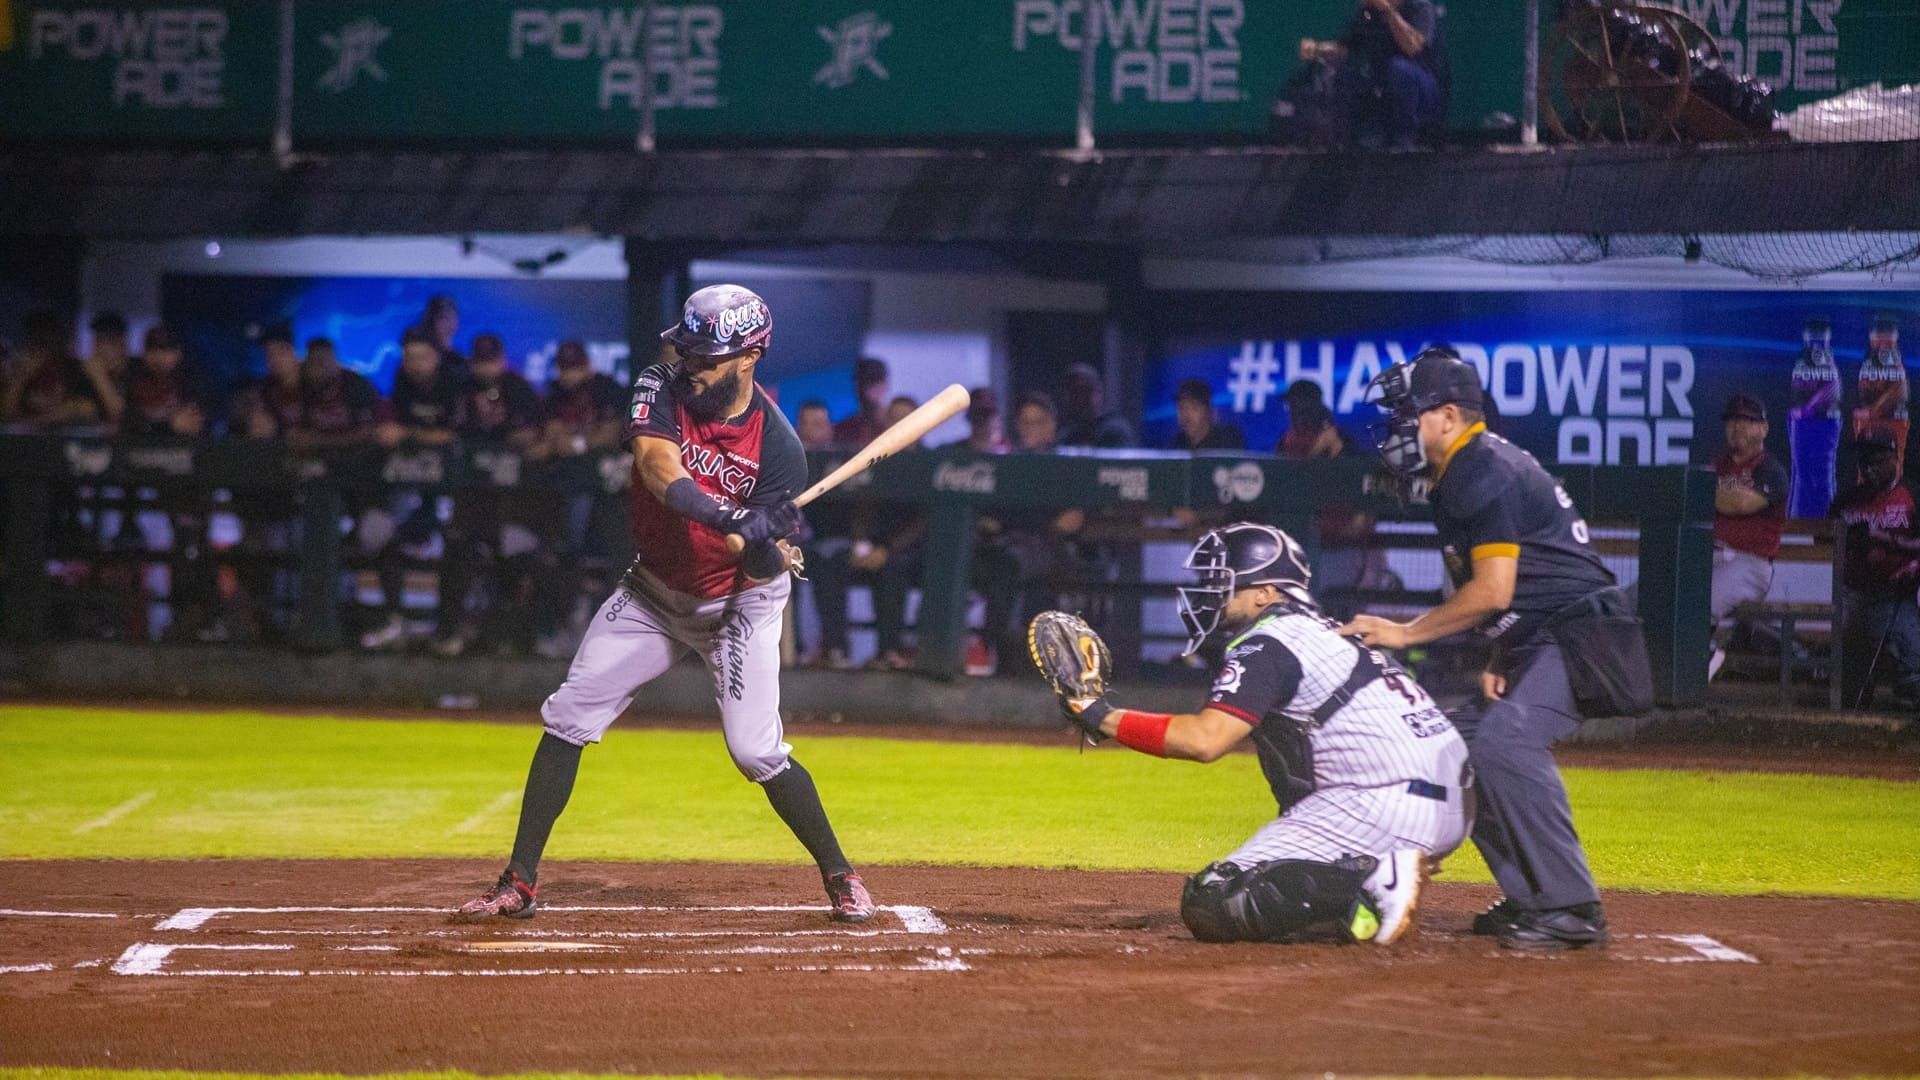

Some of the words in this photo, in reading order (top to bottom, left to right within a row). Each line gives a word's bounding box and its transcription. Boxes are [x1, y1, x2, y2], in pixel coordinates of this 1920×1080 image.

[31, 10, 229, 59] POWER
[510, 6, 723, 58] POWER
[1012, 0, 1245, 50] POWER
[115, 60, 226, 107] ADE
[601, 58, 719, 109] ADE
[1112, 51, 1241, 102] ADE
[724, 606, 754, 701] Caliente
